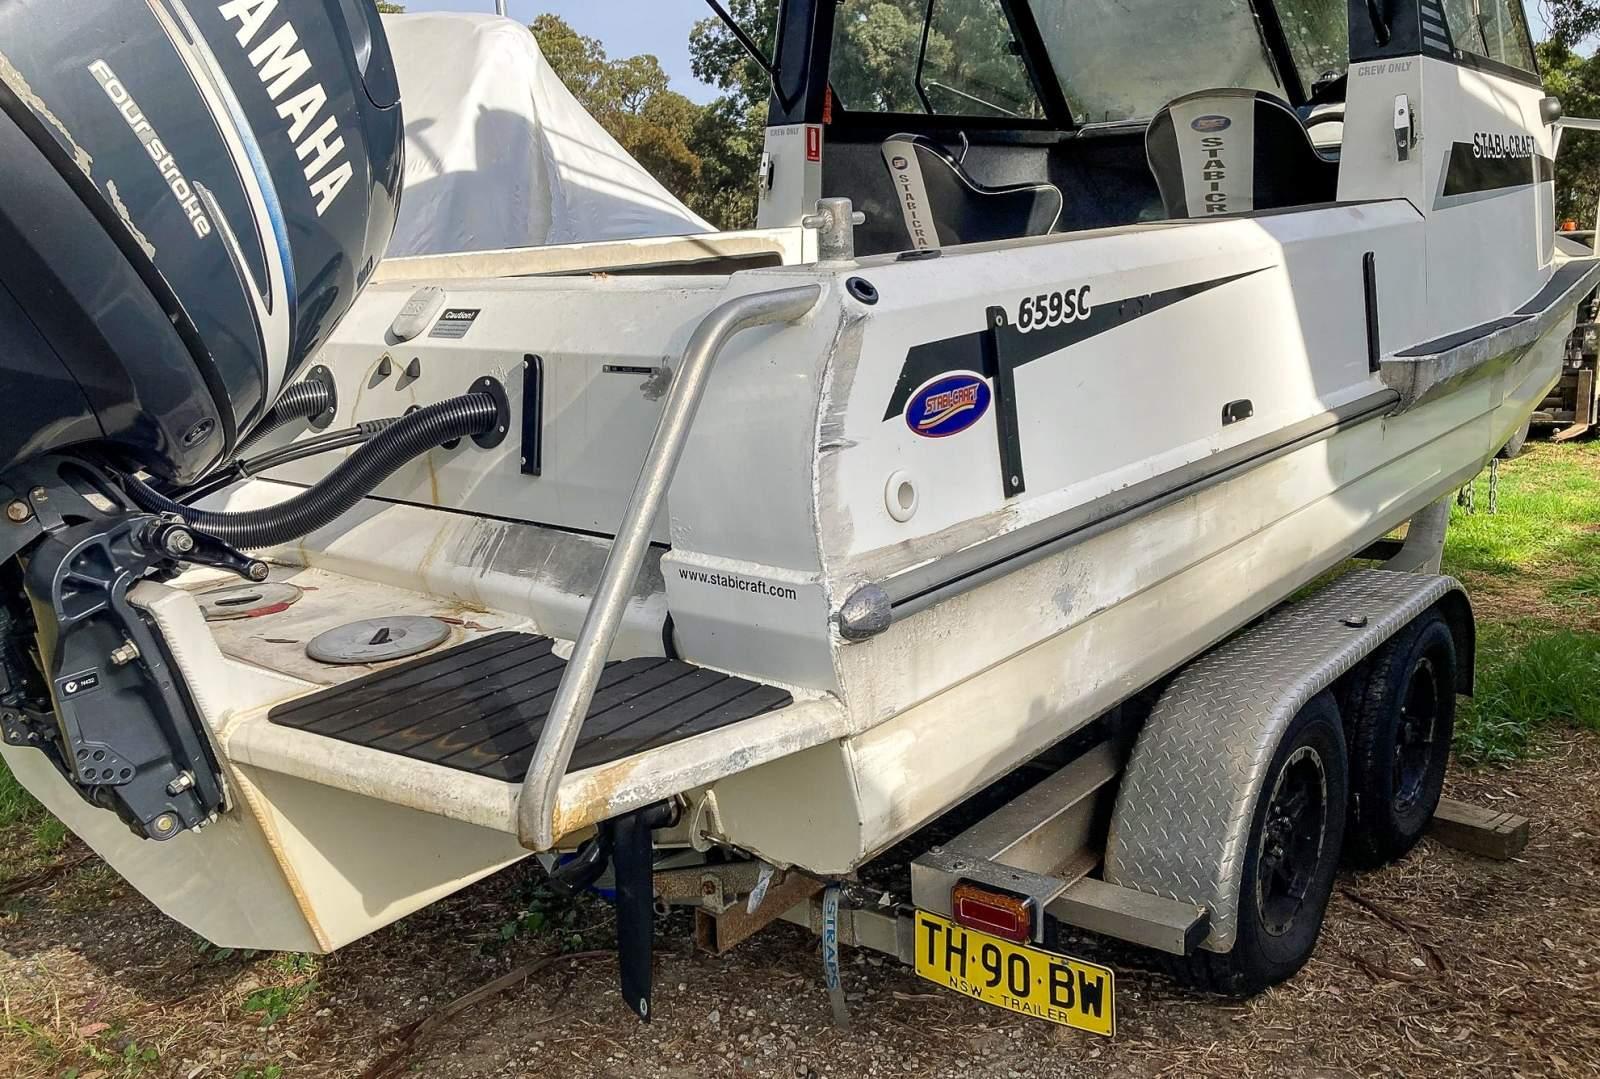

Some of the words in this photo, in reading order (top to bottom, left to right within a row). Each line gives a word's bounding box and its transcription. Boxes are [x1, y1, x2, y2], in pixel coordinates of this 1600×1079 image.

[1358, 65, 1386, 77] CREW
[1388, 61, 1412, 73] ONLY
[217, 0, 353, 217] AMAHA
[1201, 137, 1227, 213] STABICR
[899, 174, 928, 249] STABICRA
[445, 311, 475, 319] Caution!
[1017, 284, 1092, 331] 659SC
[679, 569, 797, 600] www.stabicraft.com
[826, 902, 839, 992] STRAPS
[949, 975, 983, 998] NSW
[1001, 995, 1069, 1024] TRAILER
